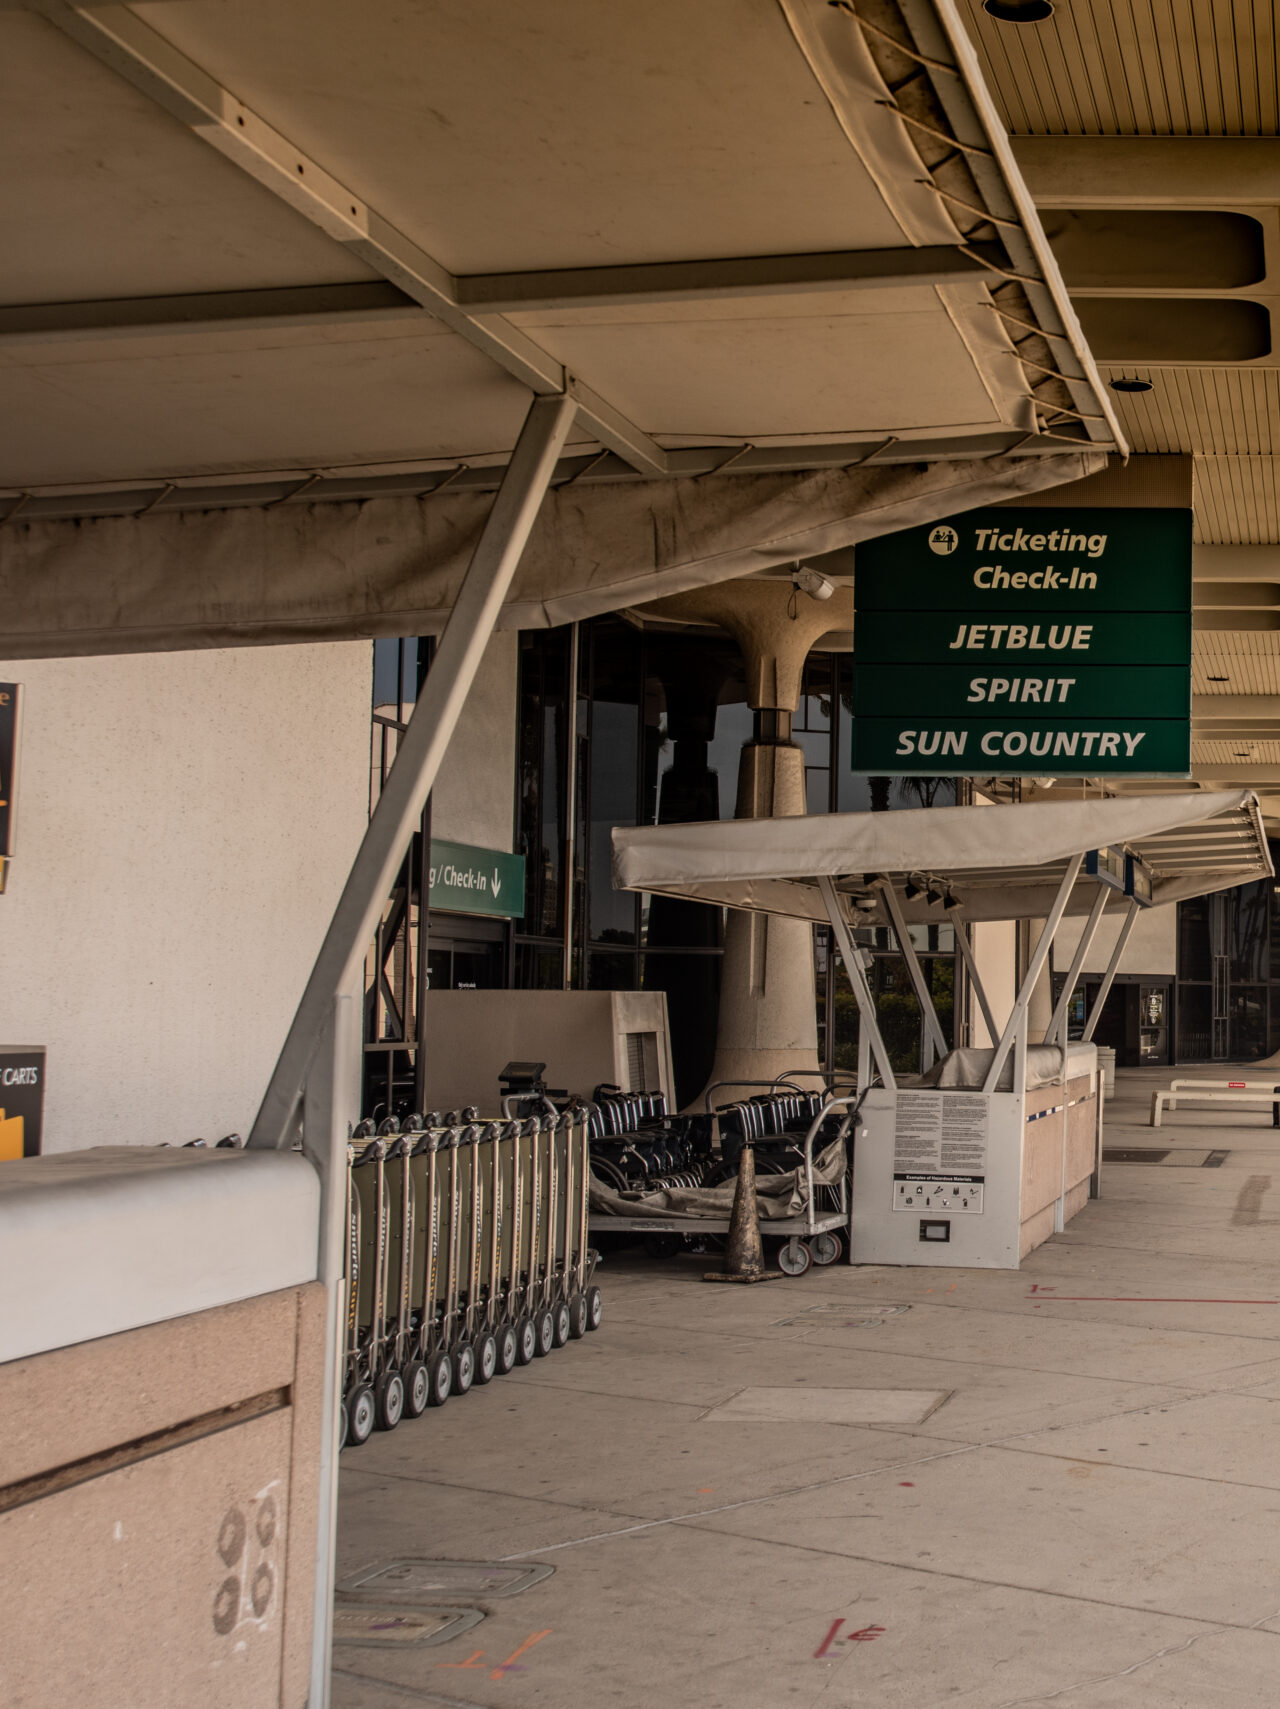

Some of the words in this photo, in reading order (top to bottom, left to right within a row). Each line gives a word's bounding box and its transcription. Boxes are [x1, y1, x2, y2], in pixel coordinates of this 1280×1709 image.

[974, 528, 1107, 557] Ticketing
[973, 565, 1097, 590] Check-In
[949, 624, 1093, 650] JETBLUE
[966, 678, 1076, 703] SPIRIT
[896, 730, 968, 756] SUN
[980, 731, 1146, 757] COUNTRY
[443, 864, 487, 891] Check-In
[3, 1067, 38, 1086] CARTS
